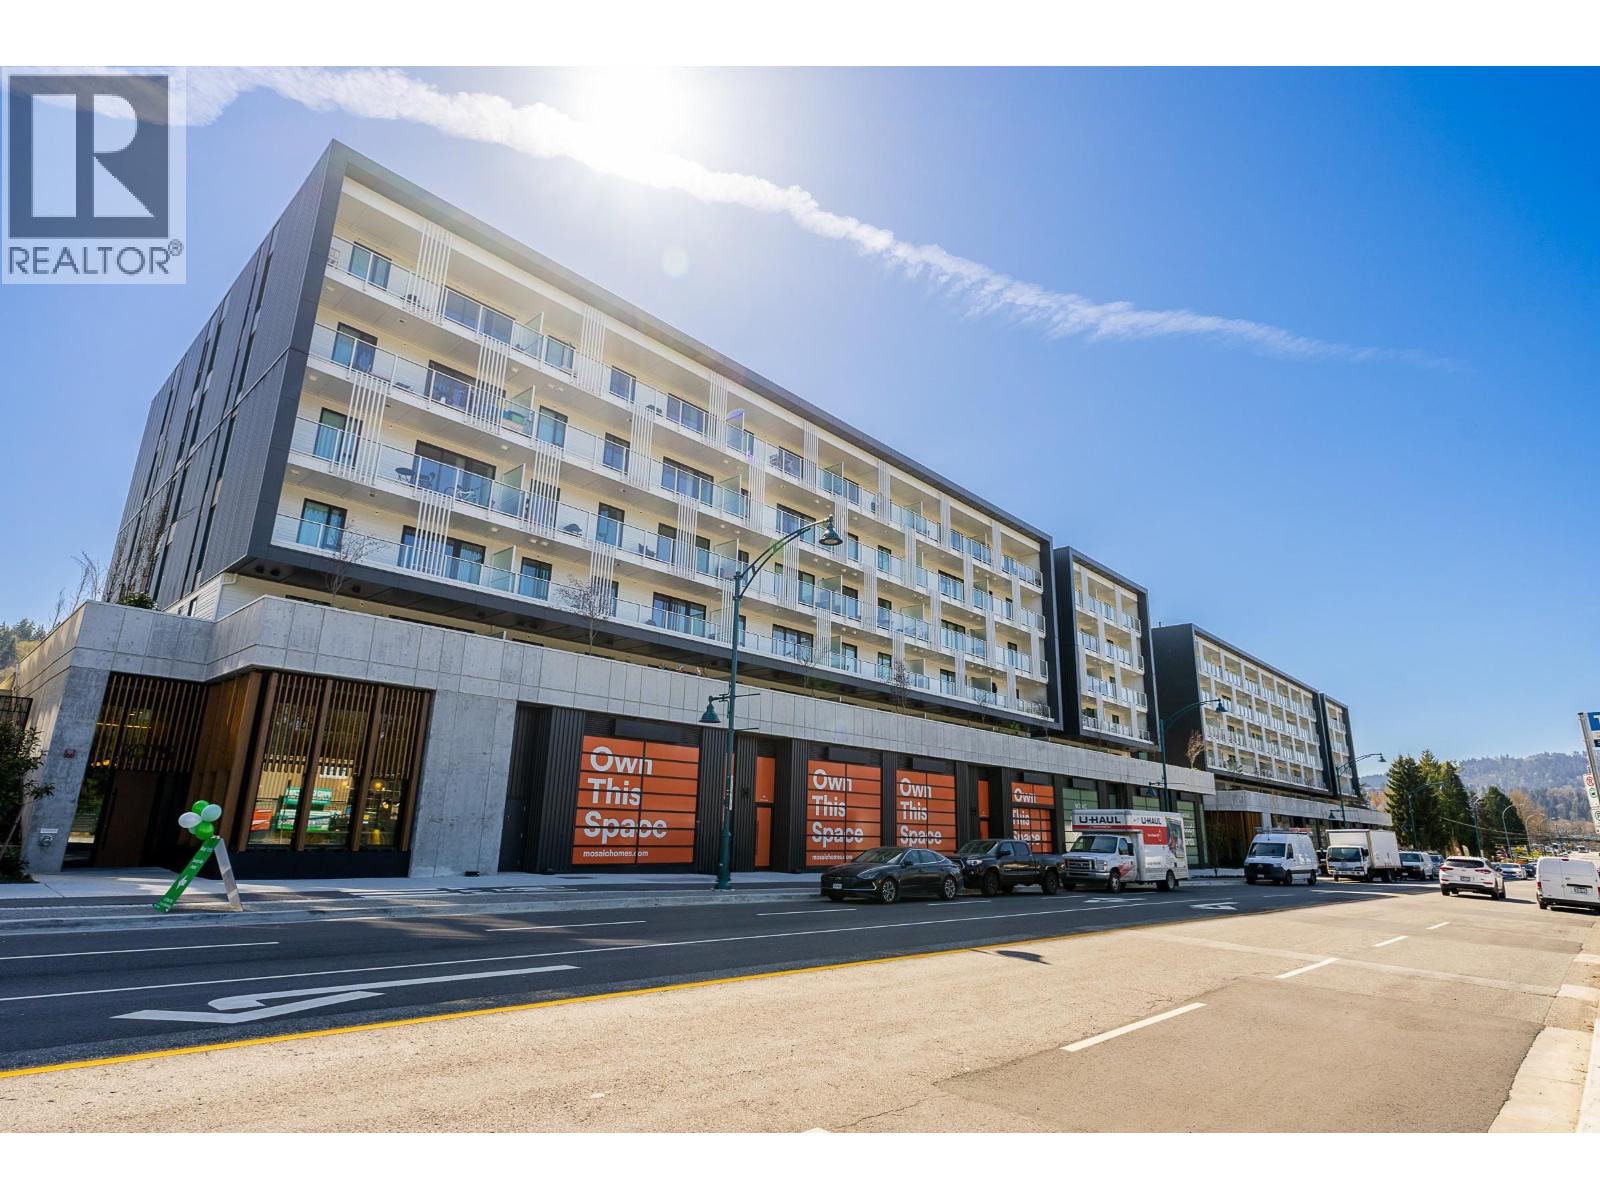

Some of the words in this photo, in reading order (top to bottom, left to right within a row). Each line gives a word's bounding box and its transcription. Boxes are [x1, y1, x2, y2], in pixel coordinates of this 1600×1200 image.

[590, 746, 653, 775] Own
[812, 768, 853, 792] Own
[900, 777, 932, 798] Own
[588, 778, 641, 806] This
[1014, 788, 1037, 804] Own
[812, 795, 846, 817] This
[900, 801, 928, 821] This
[583, 810, 668, 845] Space
[1078, 815, 1121, 824] U-HAUL
[1141, 816, 1162, 825] U-HAUL
[812, 821, 864, 848] Space
[900, 825, 942, 846] Space
